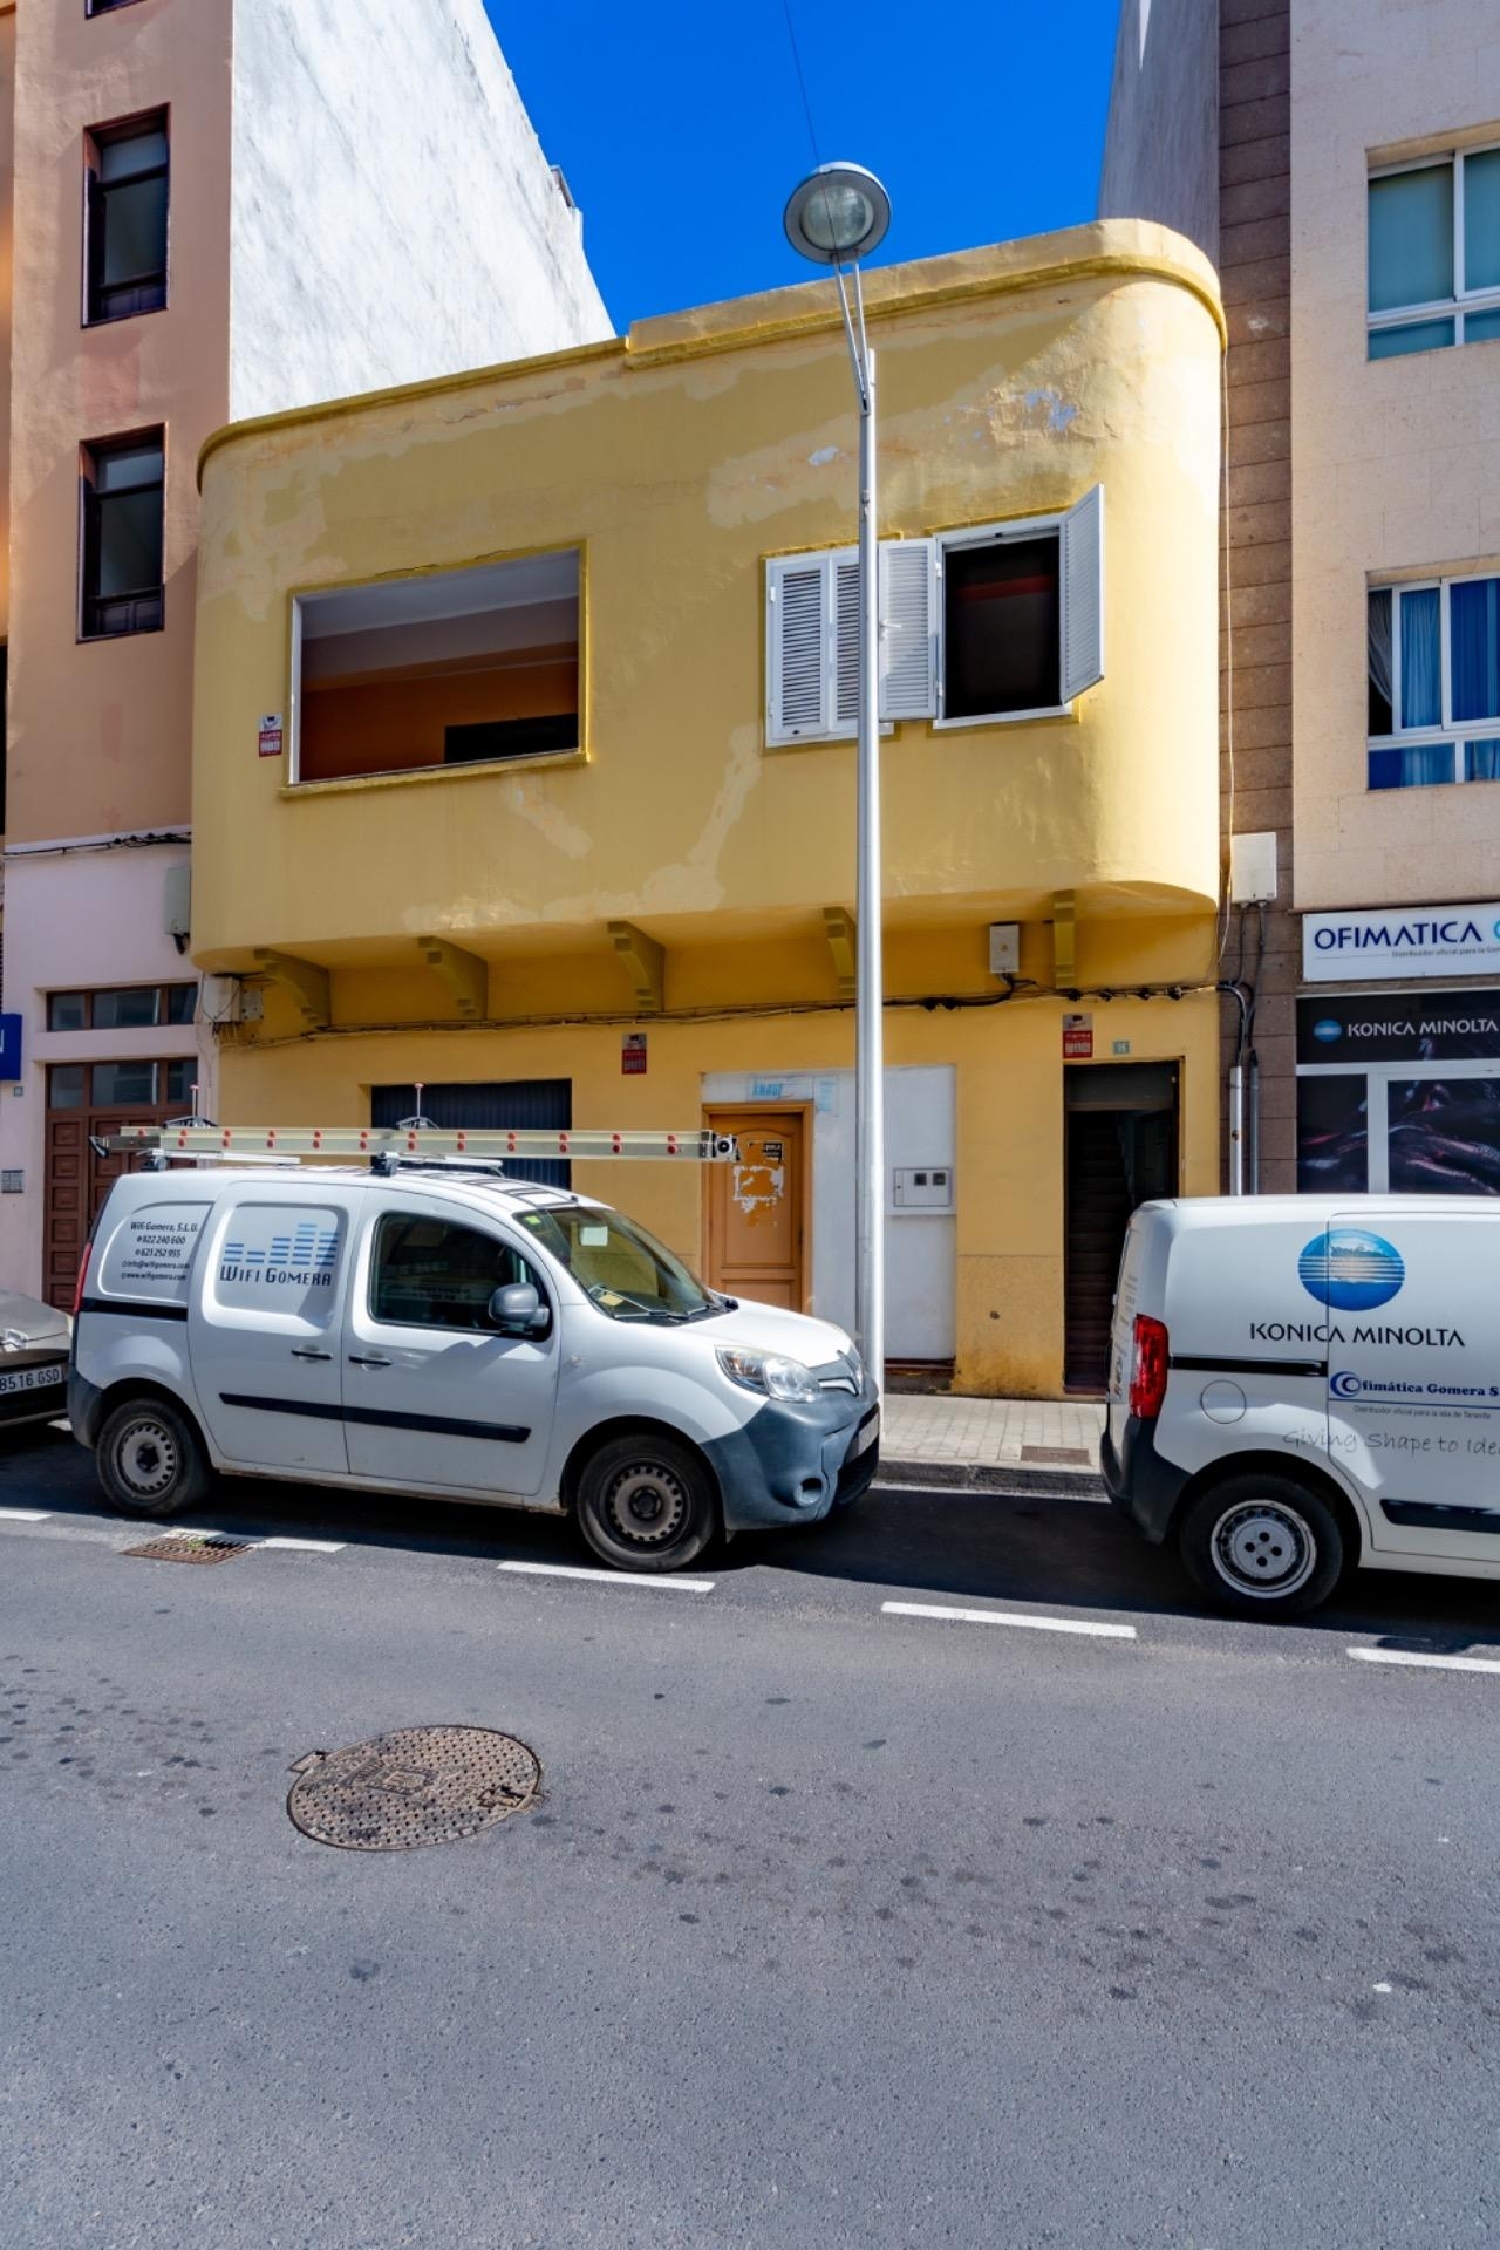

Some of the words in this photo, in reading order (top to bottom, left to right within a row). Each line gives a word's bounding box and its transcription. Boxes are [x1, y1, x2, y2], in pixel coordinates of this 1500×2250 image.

[1315, 921, 1482, 949] OFIMATICA
[1348, 1022, 1415, 1037] KONICA
[1420, 1019, 1499, 1034] MINOLTA
[1250, 1322, 1345, 1343] KONICA
[1352, 1327, 1465, 1347] MINOLTA
[1427, 1383, 1486, 1396] Gomera
[1282, 1430, 1357, 1453] Giving
[1364, 1430, 1432, 1455] Shape
[1439, 1434, 1459, 1453] to
[1467, 1437, 1500, 1455] Ide
